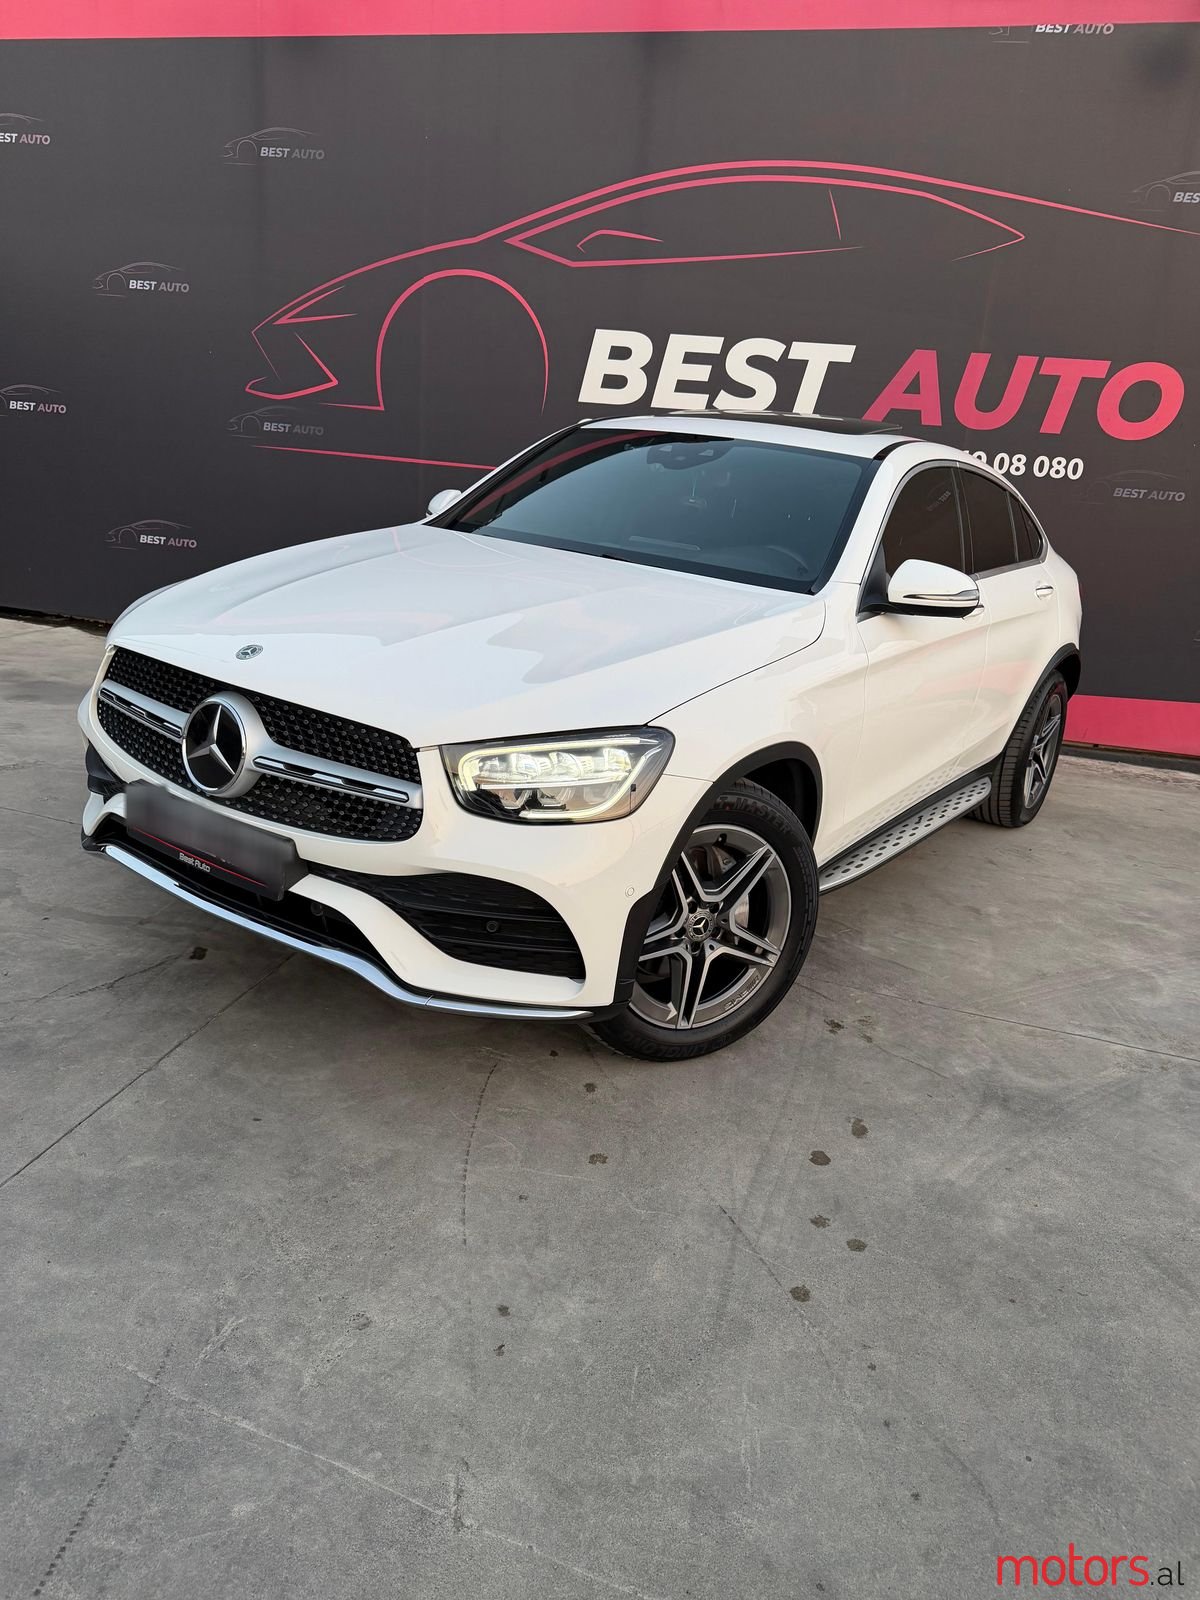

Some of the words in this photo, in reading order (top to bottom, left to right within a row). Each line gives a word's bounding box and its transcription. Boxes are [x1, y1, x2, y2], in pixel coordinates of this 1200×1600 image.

[1035, 24, 1072, 33] BEST
[1073, 23, 1114, 35] AUTO
[0, 132, 18, 143] EST
[20, 133, 51, 145] AUTO
[260, 146, 290, 158] BEST
[291, 148, 325, 160] AUTO
[1172, 191, 1200, 204] BES
[128, 279, 157, 291] BEST
[158, 281, 190, 293] AUTO
[578, 328, 857, 417] BEST
[861, 349, 1185, 441] AUTO
[9, 400, 36, 411] BEST
[37, 403, 67, 414] AUTO
[263, 421, 291, 433] BEST
[293, 424, 324, 436] AUTO
[993, 452, 1027, 476] 08
[1033, 455, 1084, 480] 080
[1112, 487, 1148, 499] BEST
[1147, 490, 1186, 502] AUTO
[139, 534, 166, 545] BEST
[167, 537, 197, 549] AUTO
[179, 852, 195, 866] Best
[195, 859, 211, 873] Auto
